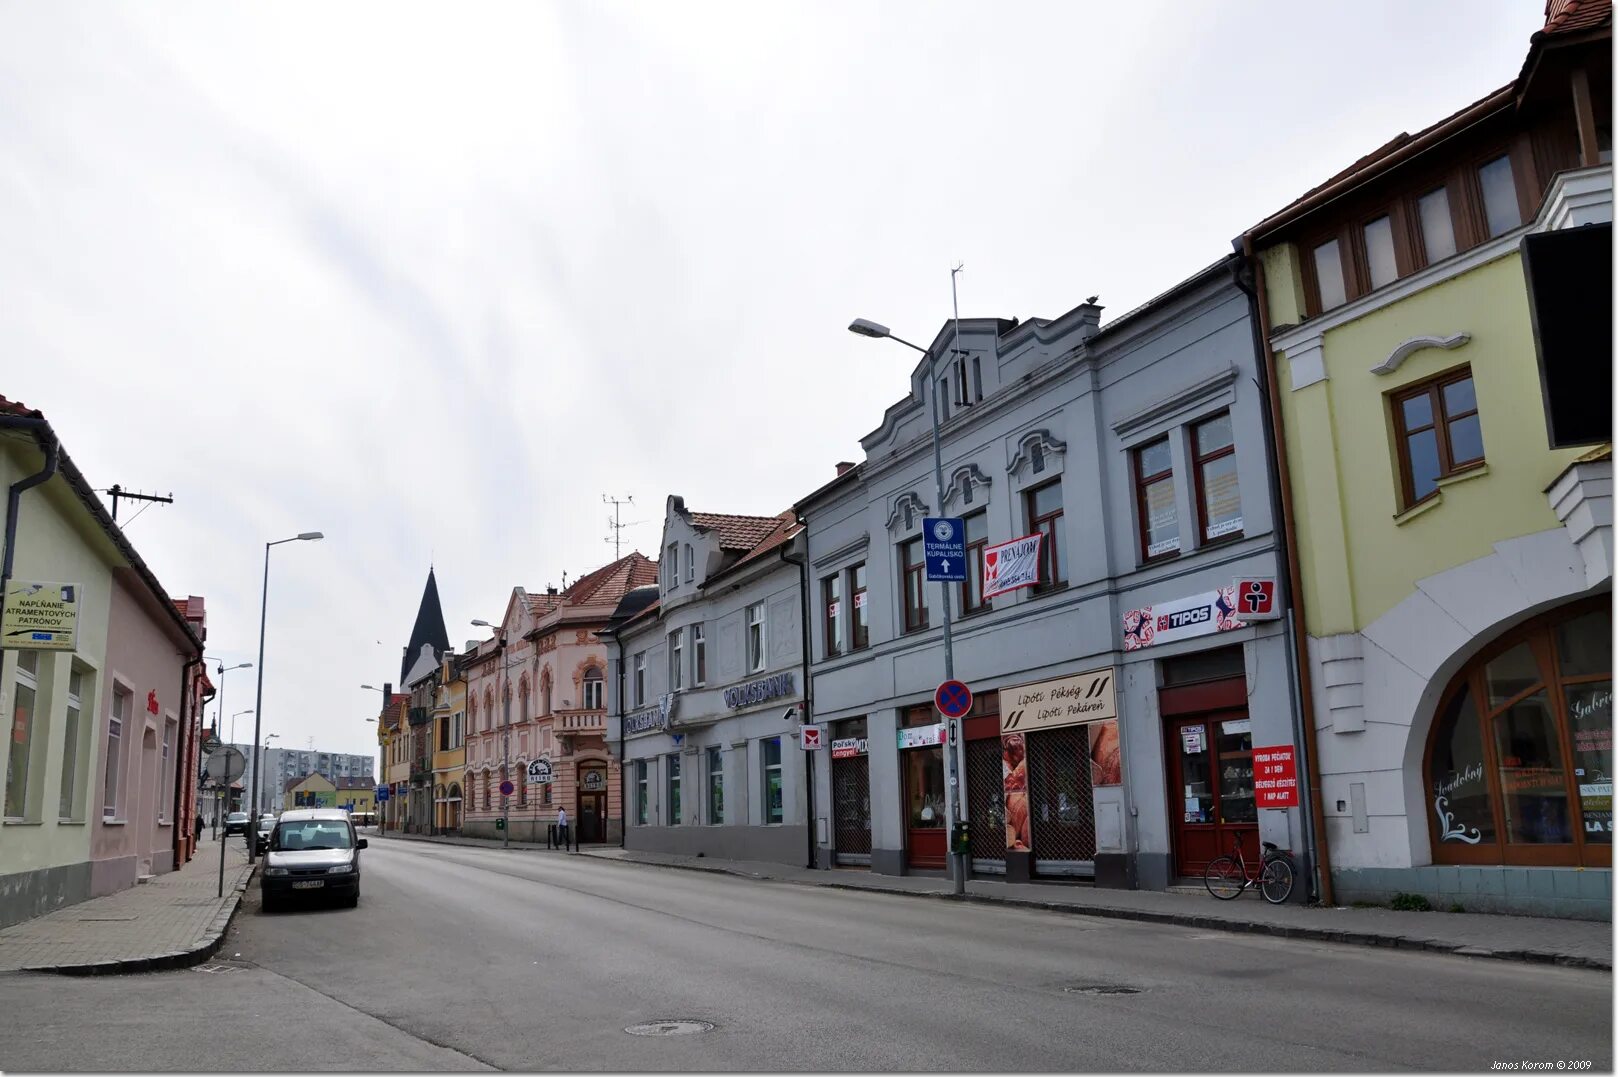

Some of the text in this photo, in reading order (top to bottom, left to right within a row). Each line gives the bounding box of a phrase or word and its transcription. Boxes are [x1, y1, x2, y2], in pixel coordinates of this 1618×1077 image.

[926, 542, 963, 550] TERMÁLNE
[926, 550, 964, 558] KÚPALISKO
[5, 608, 76, 618] ATRAMENTOVÝCH
[1170, 606, 1210, 627] TIPOS
[18, 617, 62, 626] PATRÓNOV
[723, 672, 793, 709] VOLKSBANK
[1050, 685, 1083, 701] Pékség
[1067, 700, 1106, 716] Pekáreň
[1267, 792, 1277, 800] NAP
[1277, 791, 1289, 800] ALATT
[1585, 821, 1604, 832] LA
